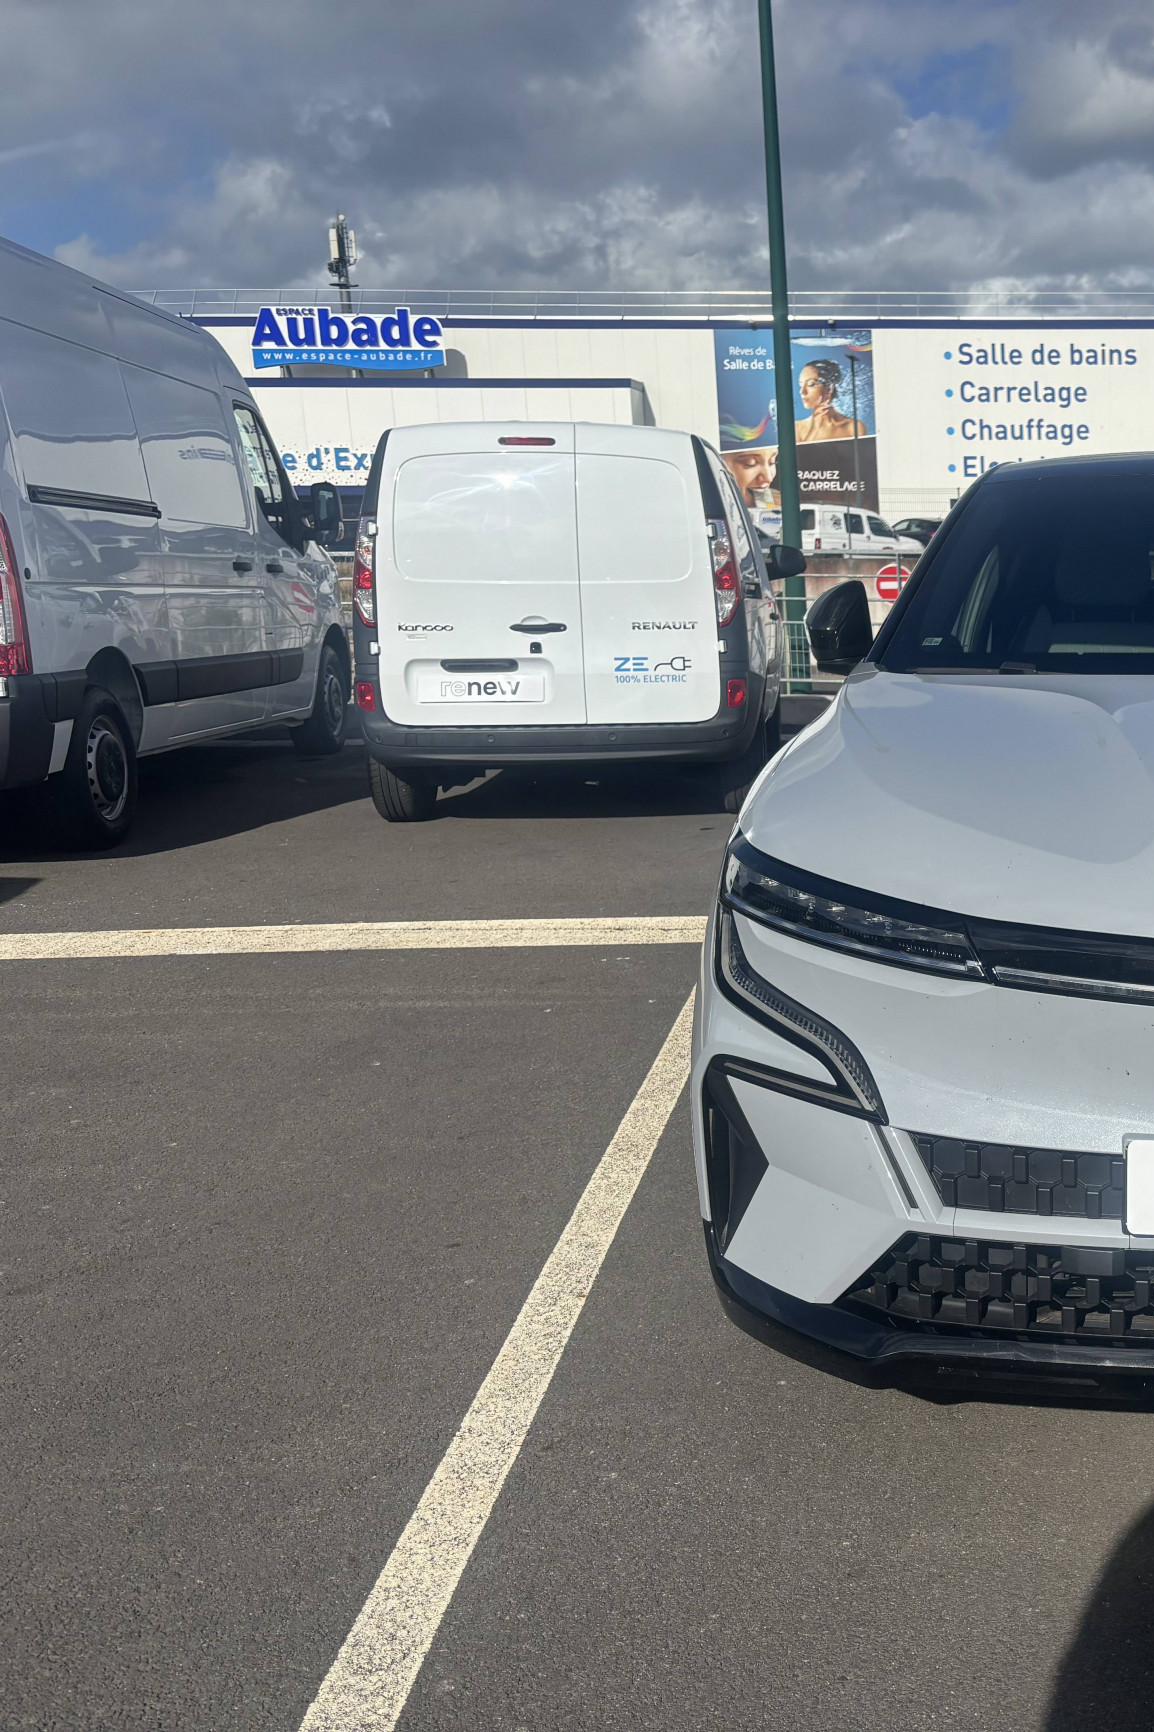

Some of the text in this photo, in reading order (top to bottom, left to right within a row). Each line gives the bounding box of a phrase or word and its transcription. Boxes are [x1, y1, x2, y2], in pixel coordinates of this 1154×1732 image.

[275, 307, 316, 317] ESPACE
[251, 307, 442, 349] Aubade
[262, 351, 433, 362] www.espace-aubade.fr
[755, 346, 767, 356] de
[958, 342, 1138, 366] Salle de bains
[723, 358, 749, 370] Salle
[750, 358, 765, 370] de
[960, 380, 1088, 409] Carrelage
[961, 418, 1091, 446] Chauffage
[306, 447, 376, 471] d'Ex
[797, 470, 840, 480] RAQUEZ
[800, 481, 866, 492] CARRELAGE
[631, 621, 698, 630] RENAULT
[614, 674, 687, 684] 100% ELECTRIC
